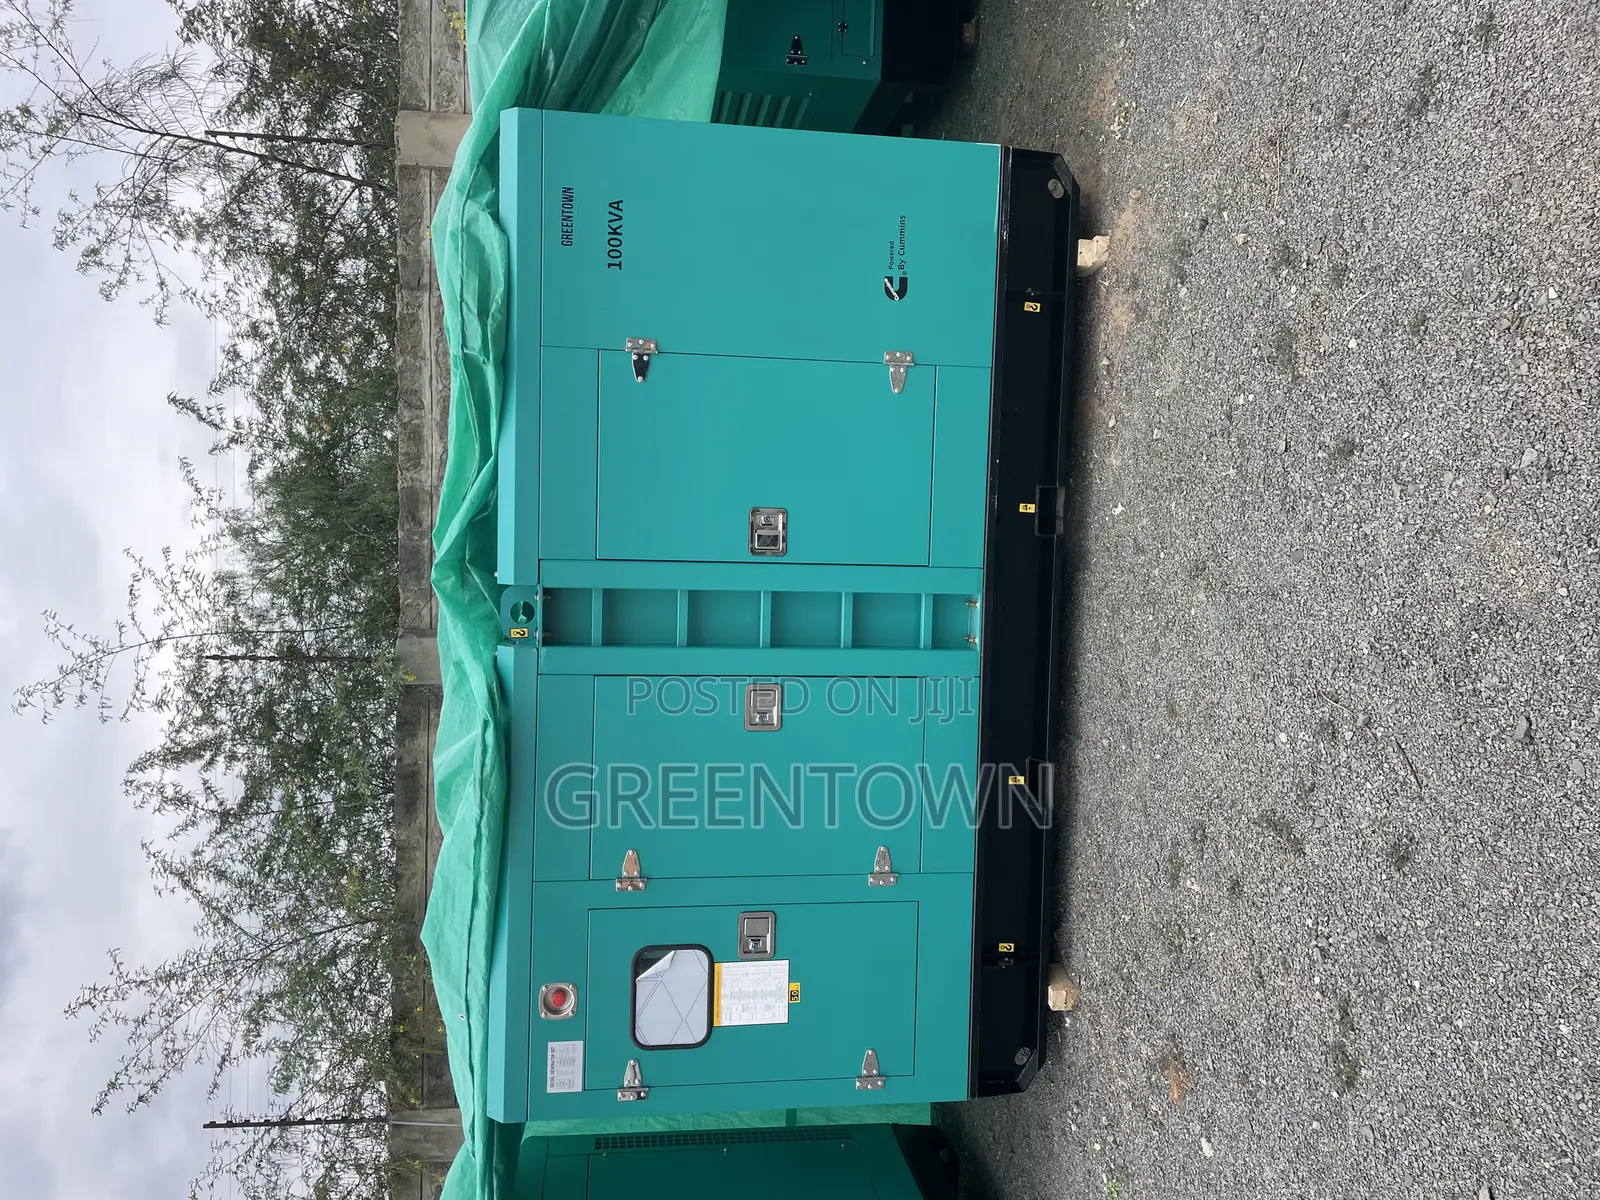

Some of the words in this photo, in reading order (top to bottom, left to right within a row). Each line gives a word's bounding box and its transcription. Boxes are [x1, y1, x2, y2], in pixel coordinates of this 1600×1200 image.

[561, 186, 574, 247] GREENTOWN
[607, 199, 624, 271] 100KVA
[898, 215, 906, 256] Cummins
[898, 259, 906, 270] By
[791, 990, 799, 1001] 50
